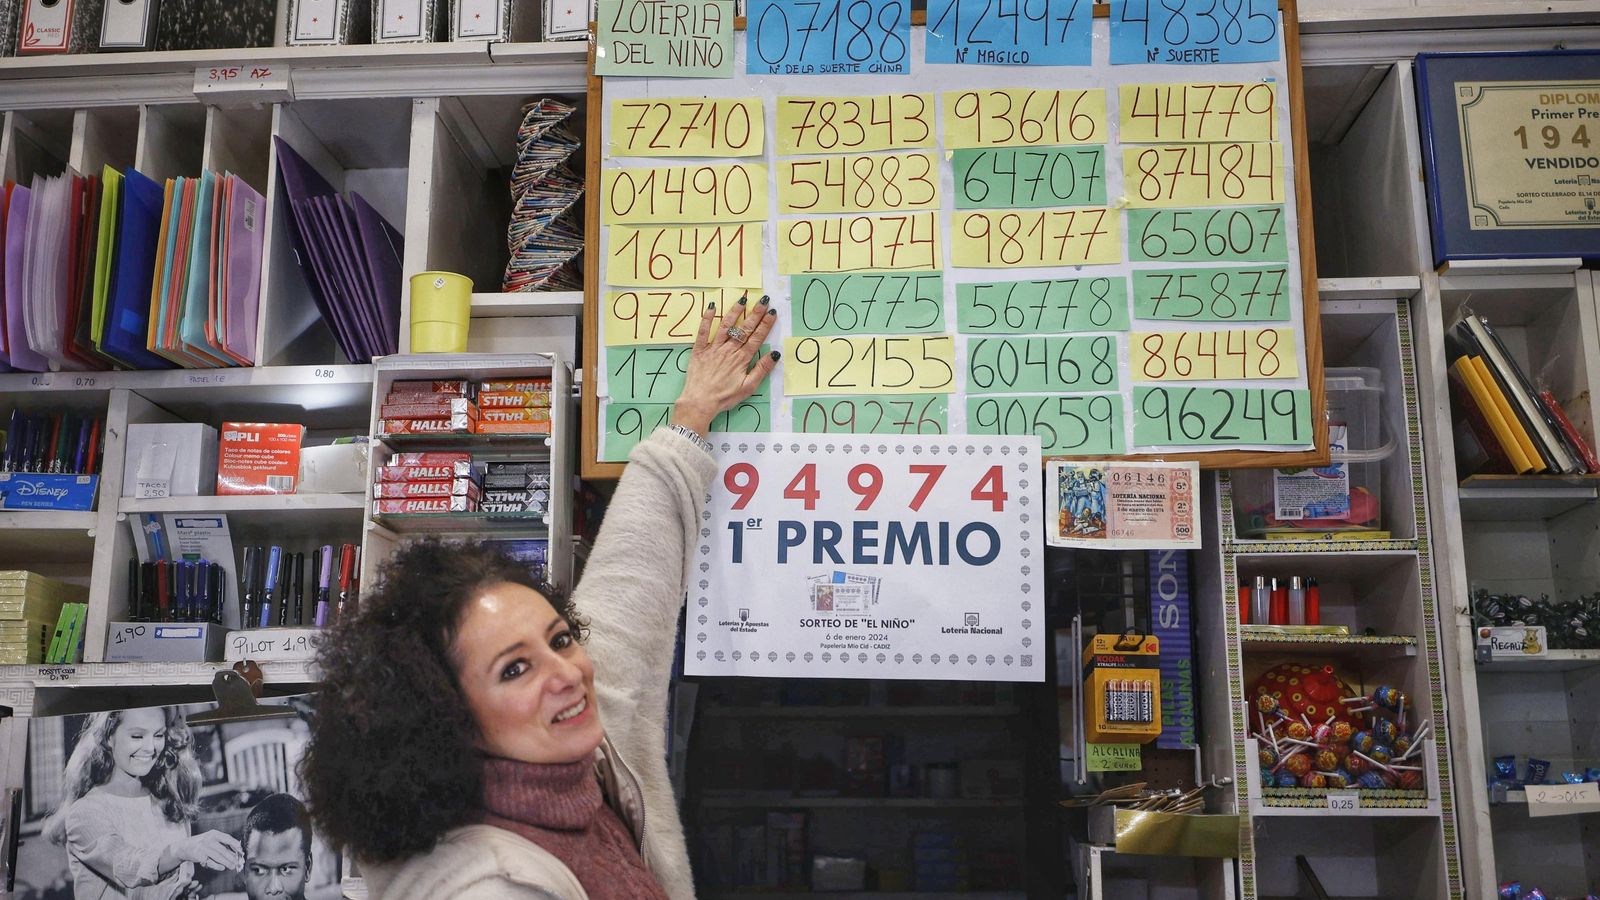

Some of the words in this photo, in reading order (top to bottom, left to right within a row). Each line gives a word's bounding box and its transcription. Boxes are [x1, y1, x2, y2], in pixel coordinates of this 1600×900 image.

[612, 0, 721, 36] LOTERIA
[757, 0, 906, 64] 07188
[932, 0, 1079, 45] 12497
[1121, 0, 1276, 45] 48385
[613, 41, 654, 64] DEL
[668, 36, 723, 68] NIÑO
[785, 64, 799, 73] DE
[801, 64, 814, 73] LA
[820, 63, 860, 73] SUERTE
[868, 63, 903, 73] CHINA
[977, 51, 1030, 64] MAGICO
[1166, 48, 1220, 63] SUERTE
[622, 102, 750, 148] 72710
[788, 95, 929, 148] 78343
[954, 90, 1095, 143] 93616
[1131, 84, 1274, 140] 44779
[1531, 109, 1574, 119] Primer
[789, 154, 935, 208] 54883
[964, 151, 1100, 204] 64707
[1138, 143, 1274, 200] 87484
[1525, 157, 1599, 169] VENDIDO
[611, 165, 752, 215] 01490
[615, 224, 744, 280] 16411
[789, 212, 935, 269] 94974
[964, 209, 1108, 263] 98177
[1141, 208, 1281, 258] 65607
[802, 275, 941, 331] 06775
[969, 278, 1112, 329] 56778
[1146, 269, 1287, 318] 75877
[315, 368, 334, 379] 0,80
[795, 337, 953, 389] 92155
[971, 336, 1113, 388] 60468
[1143, 329, 1280, 378] 86448
[76, 378, 95, 386] 0,70
[483, 396, 523, 405] HALLS
[410, 420, 451, 431] HALLS
[485, 412, 524, 421] HALLS
[976, 395, 1114, 450] 90659
[1142, 387, 1298, 441] 96249
[408, 484, 450, 494] HALLS
[409, 466, 451, 477] HALLS
[406, 501, 448, 511] HALLS
[481, 504, 522, 512] HALLS
[486, 493, 526, 501] HALLS
[777, 520, 1002, 566] PREMIO
[115, 626, 146, 645] 1,90
[800, 619, 841, 628] SORTEO
[845, 619, 858, 628] DE
[861, 618, 878, 628] "EL
[881, 618, 915, 629] NIÑO"
[970, 626, 1003, 635] Nacional
[1162, 680, 1175, 727] PILAS
[1177, 658, 1195, 749] ALCALINAS
[1331, 799, 1354, 810] 0,25
